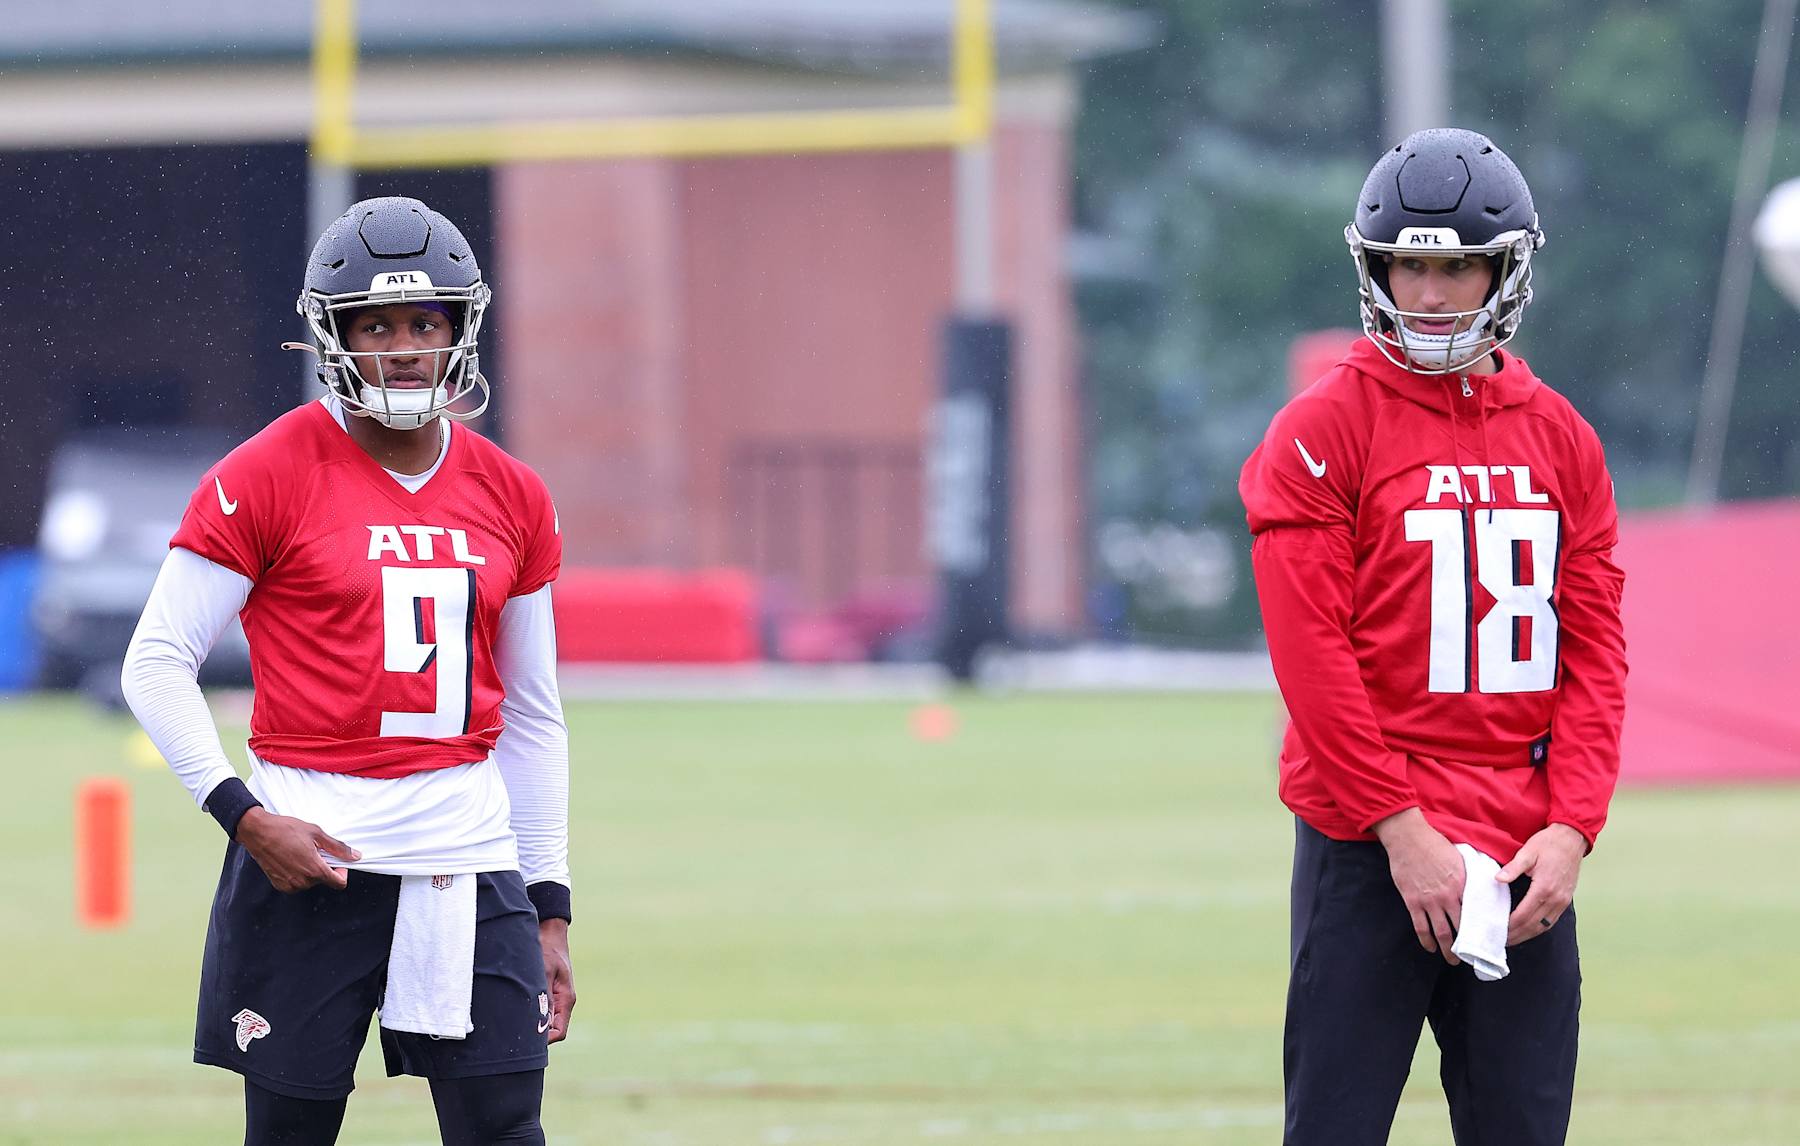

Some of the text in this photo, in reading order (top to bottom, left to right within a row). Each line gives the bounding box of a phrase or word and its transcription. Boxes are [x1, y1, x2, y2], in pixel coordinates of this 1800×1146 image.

[1410, 234, 1442, 244] ATL
[387, 275, 418, 284] ATL
[1425, 465, 1549, 504] ATL
[366, 525, 486, 566] ATL
[1404, 509, 1561, 694] 18
[380, 566, 476, 738] 9
